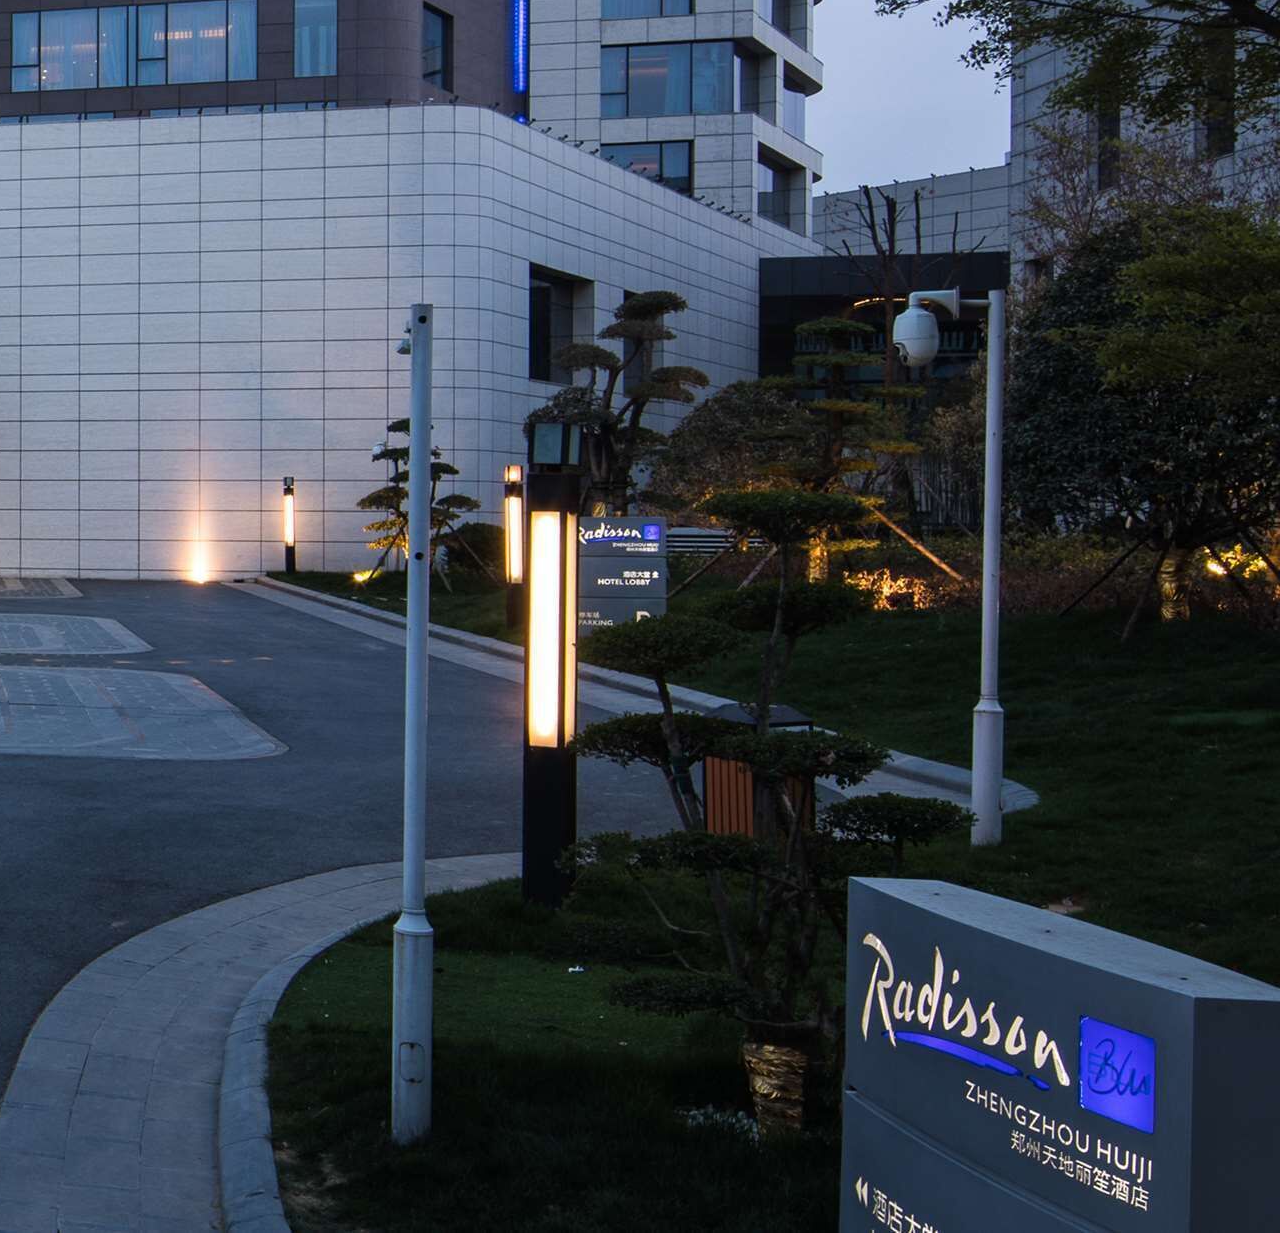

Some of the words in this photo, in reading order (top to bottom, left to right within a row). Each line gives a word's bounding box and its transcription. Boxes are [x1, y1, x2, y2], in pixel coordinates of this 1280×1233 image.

[861, 932, 1071, 1087] Radisson
[965, 1080, 1090, 1153] ZHENGZHOU
[1097, 1138, 1153, 1184] HUIJI
[1010, 1129, 1150, 1212] 郑州天地丽笙酒店
